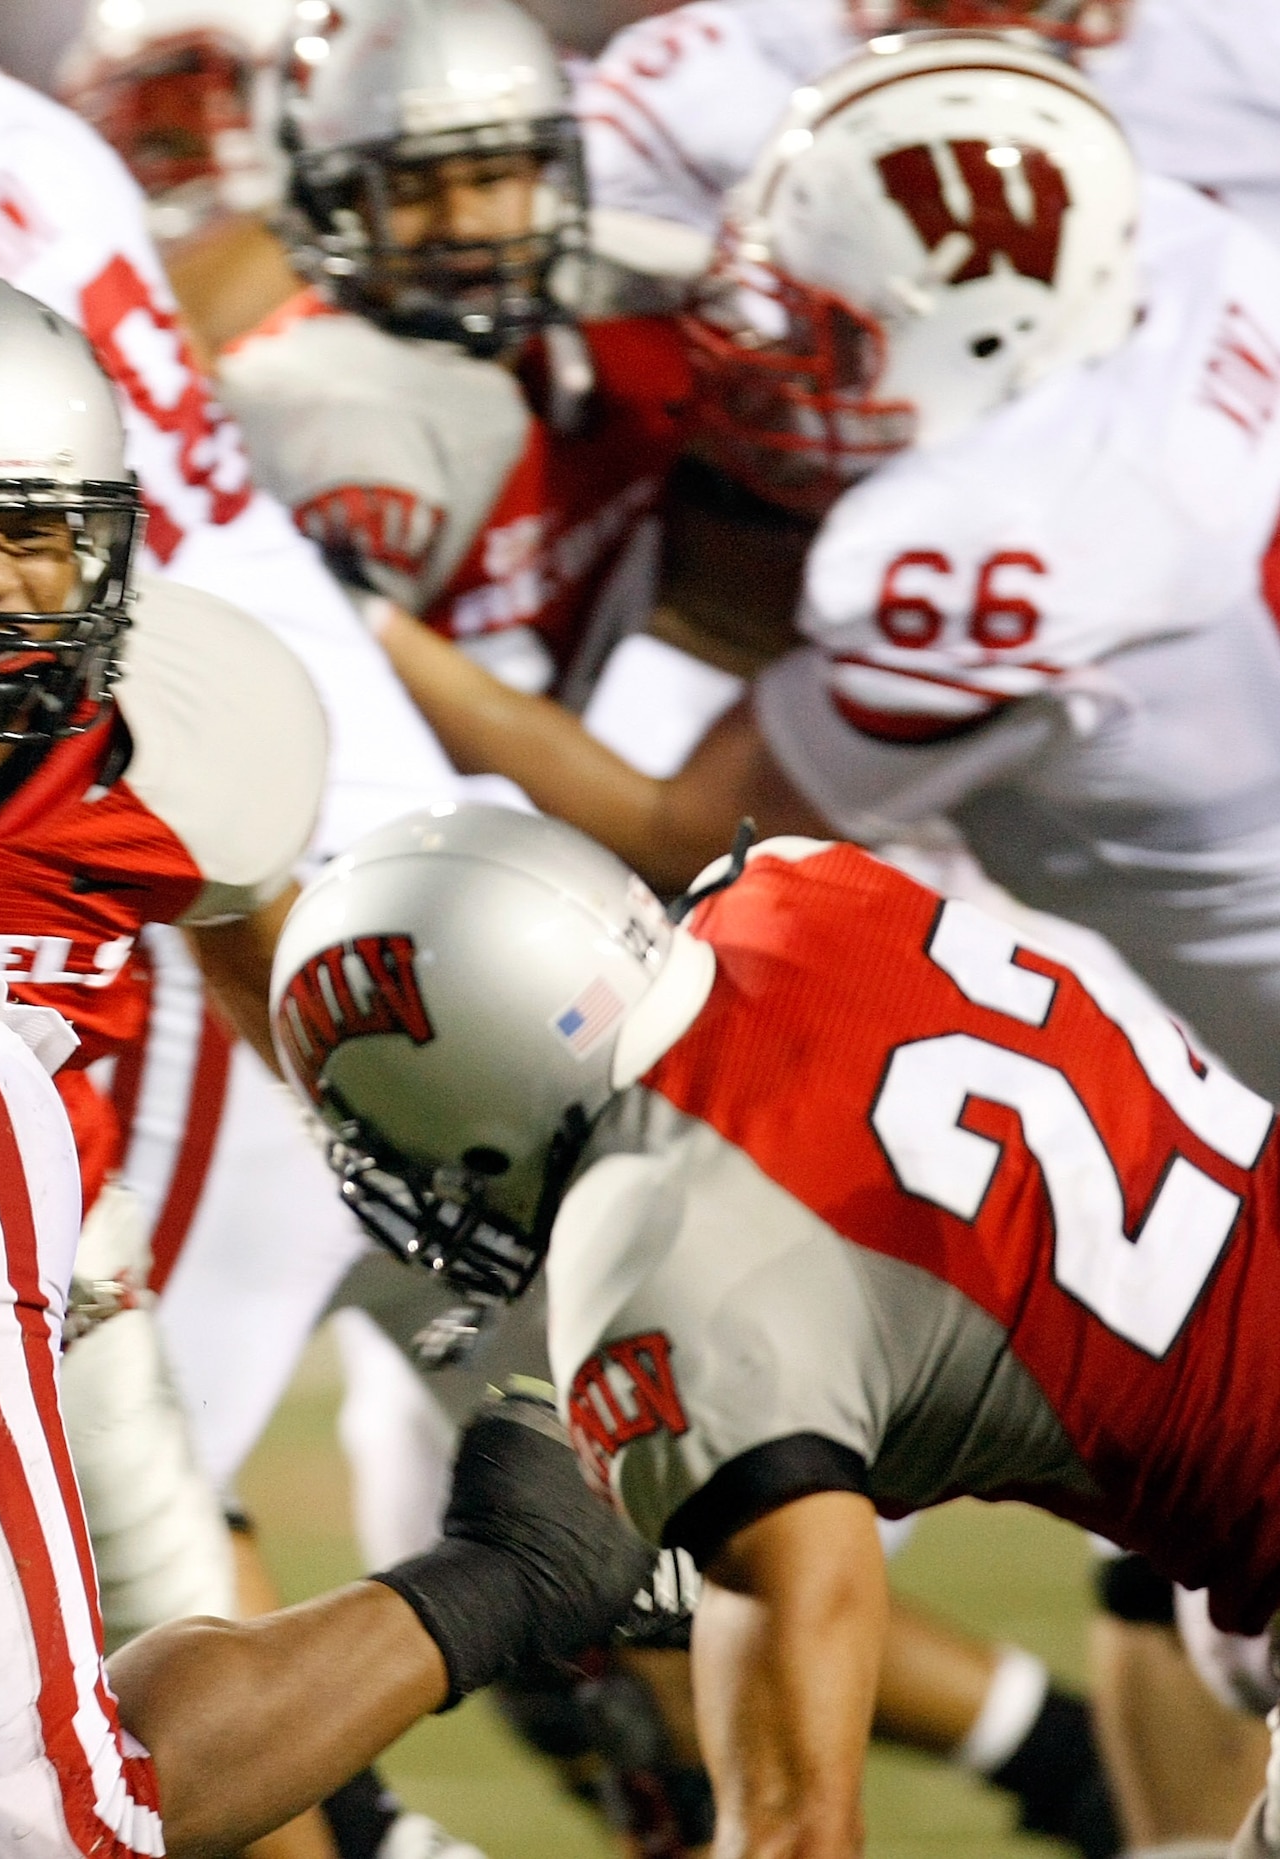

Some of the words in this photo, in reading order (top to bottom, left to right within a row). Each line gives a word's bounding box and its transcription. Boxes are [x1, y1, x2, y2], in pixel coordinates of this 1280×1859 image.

[876, 138, 1074, 288] W
[875, 549, 1048, 650] 66
[868, 896, 1277, 1364] 22
